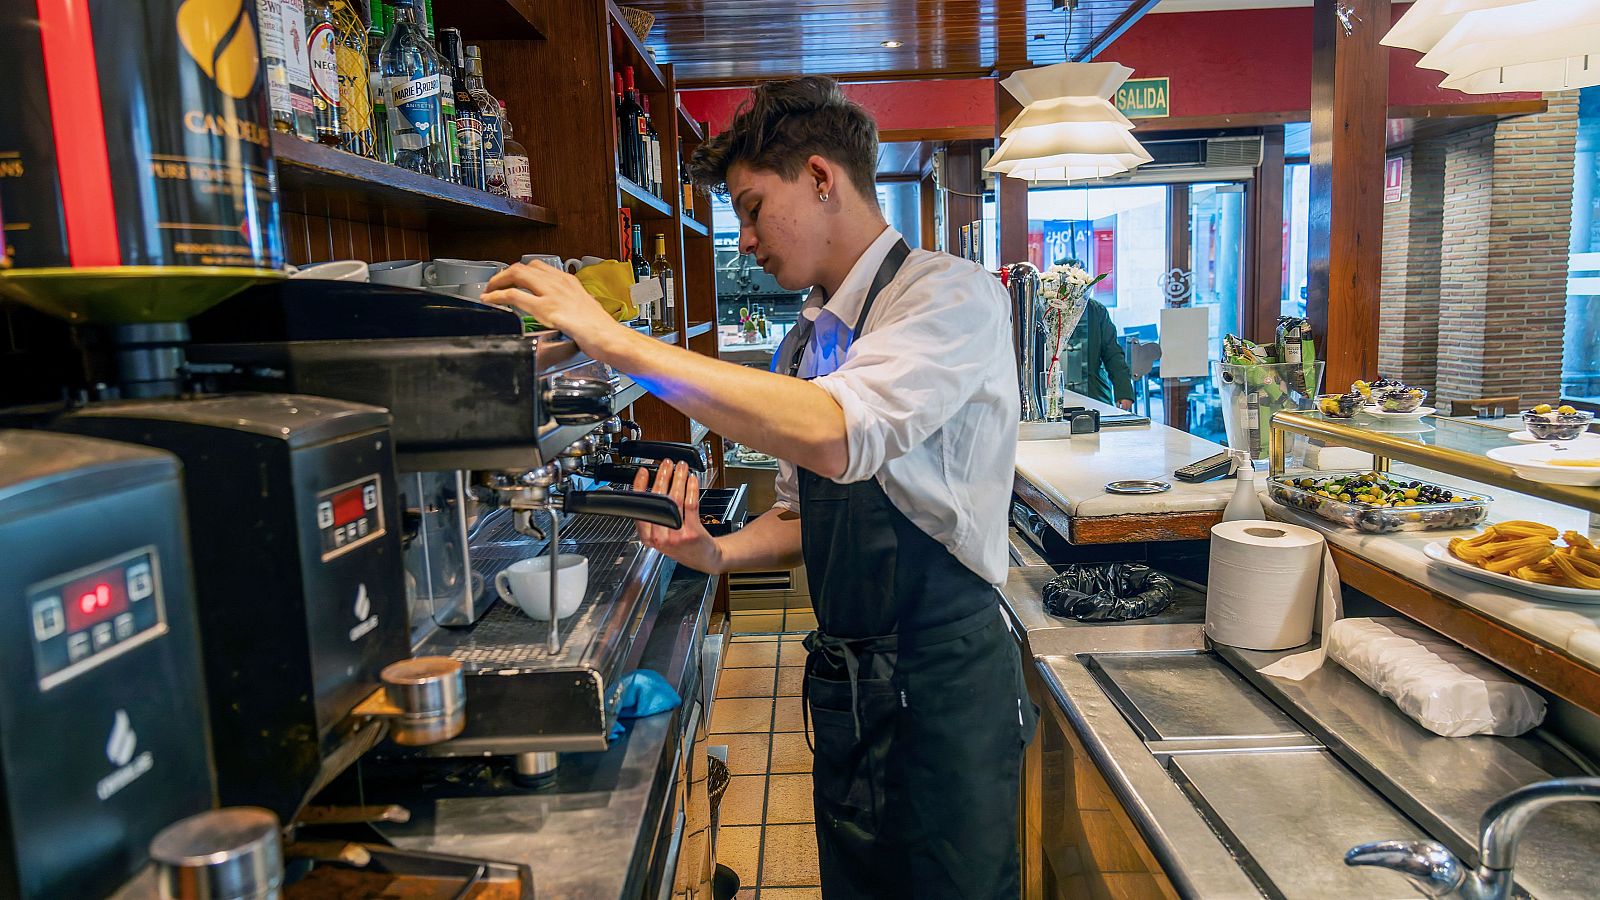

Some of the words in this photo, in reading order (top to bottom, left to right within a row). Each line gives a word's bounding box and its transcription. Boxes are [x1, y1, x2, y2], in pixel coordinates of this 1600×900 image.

[394, 86, 415, 101] MARIE
[416, 80, 439, 97] BRIZARD
[1118, 87, 1166, 110] SALIDA
